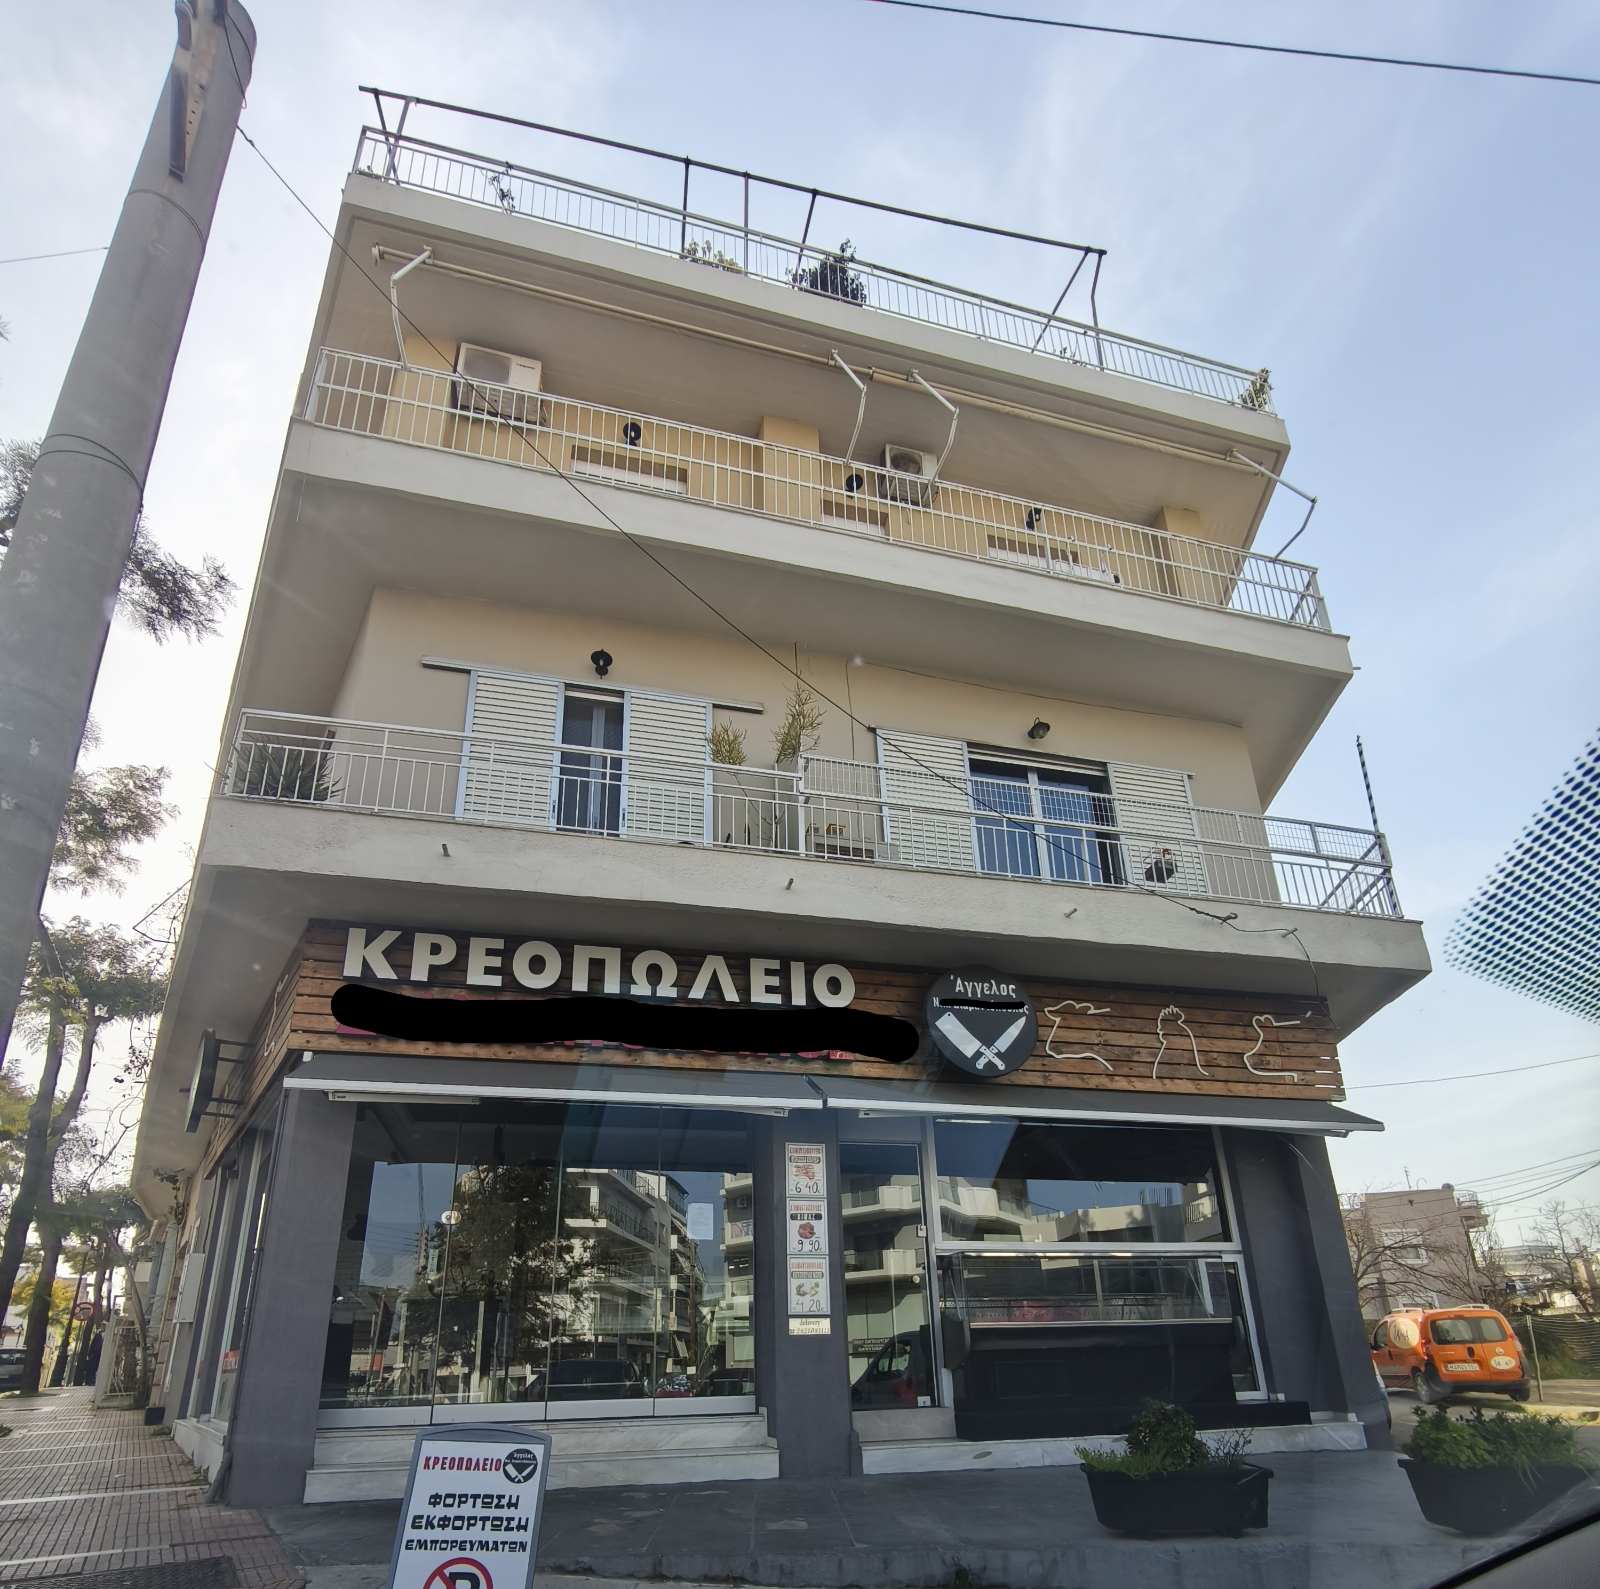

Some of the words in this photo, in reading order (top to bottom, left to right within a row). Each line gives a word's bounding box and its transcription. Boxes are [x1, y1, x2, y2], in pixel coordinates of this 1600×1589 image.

[342, 927, 857, 1008] ΚΡΕΟΠΩΛΕΙΟ
[423, 1455, 502, 1472] ΚΡΕΟΠΩΛΕΙΟ
[428, 1493, 520, 1510] ΦΟΡΤΩΣΗ
[410, 1514, 529, 1532] ΕΚΦΟΡΤΩΣΗ
[404, 1538, 528, 1553] ΕΜΠΟΡΕΥΜΑΤΩΝ
